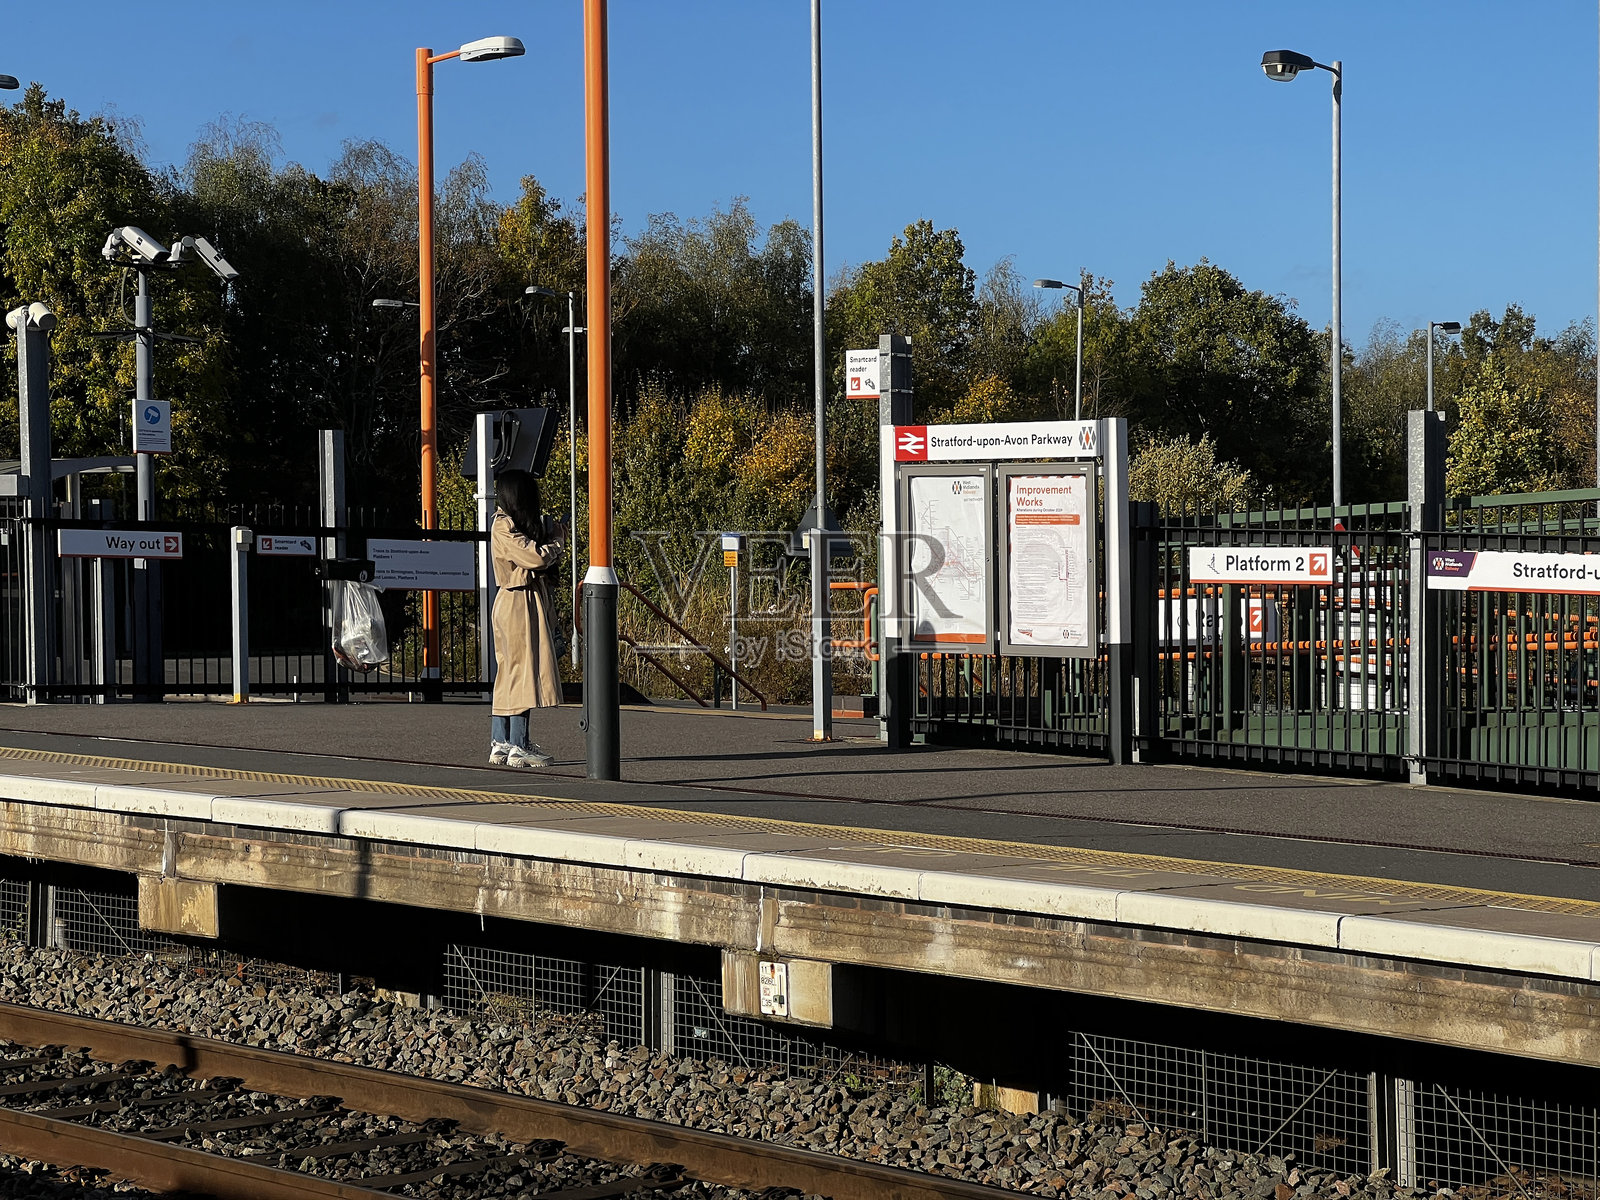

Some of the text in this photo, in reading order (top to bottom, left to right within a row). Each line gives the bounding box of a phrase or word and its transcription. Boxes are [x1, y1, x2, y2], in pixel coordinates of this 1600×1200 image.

[931, 433, 1073, 448] Stratford-upon-Avon Parkway
[1016, 485, 1072, 496] Improvement
[1016, 497, 1043, 506] Works
[106, 536, 160, 552] Way out
[1226, 555, 1305, 571] Platform 2
[1029, 864, 1156, 878] THE
[1232, 884, 1426, 906] MIND
